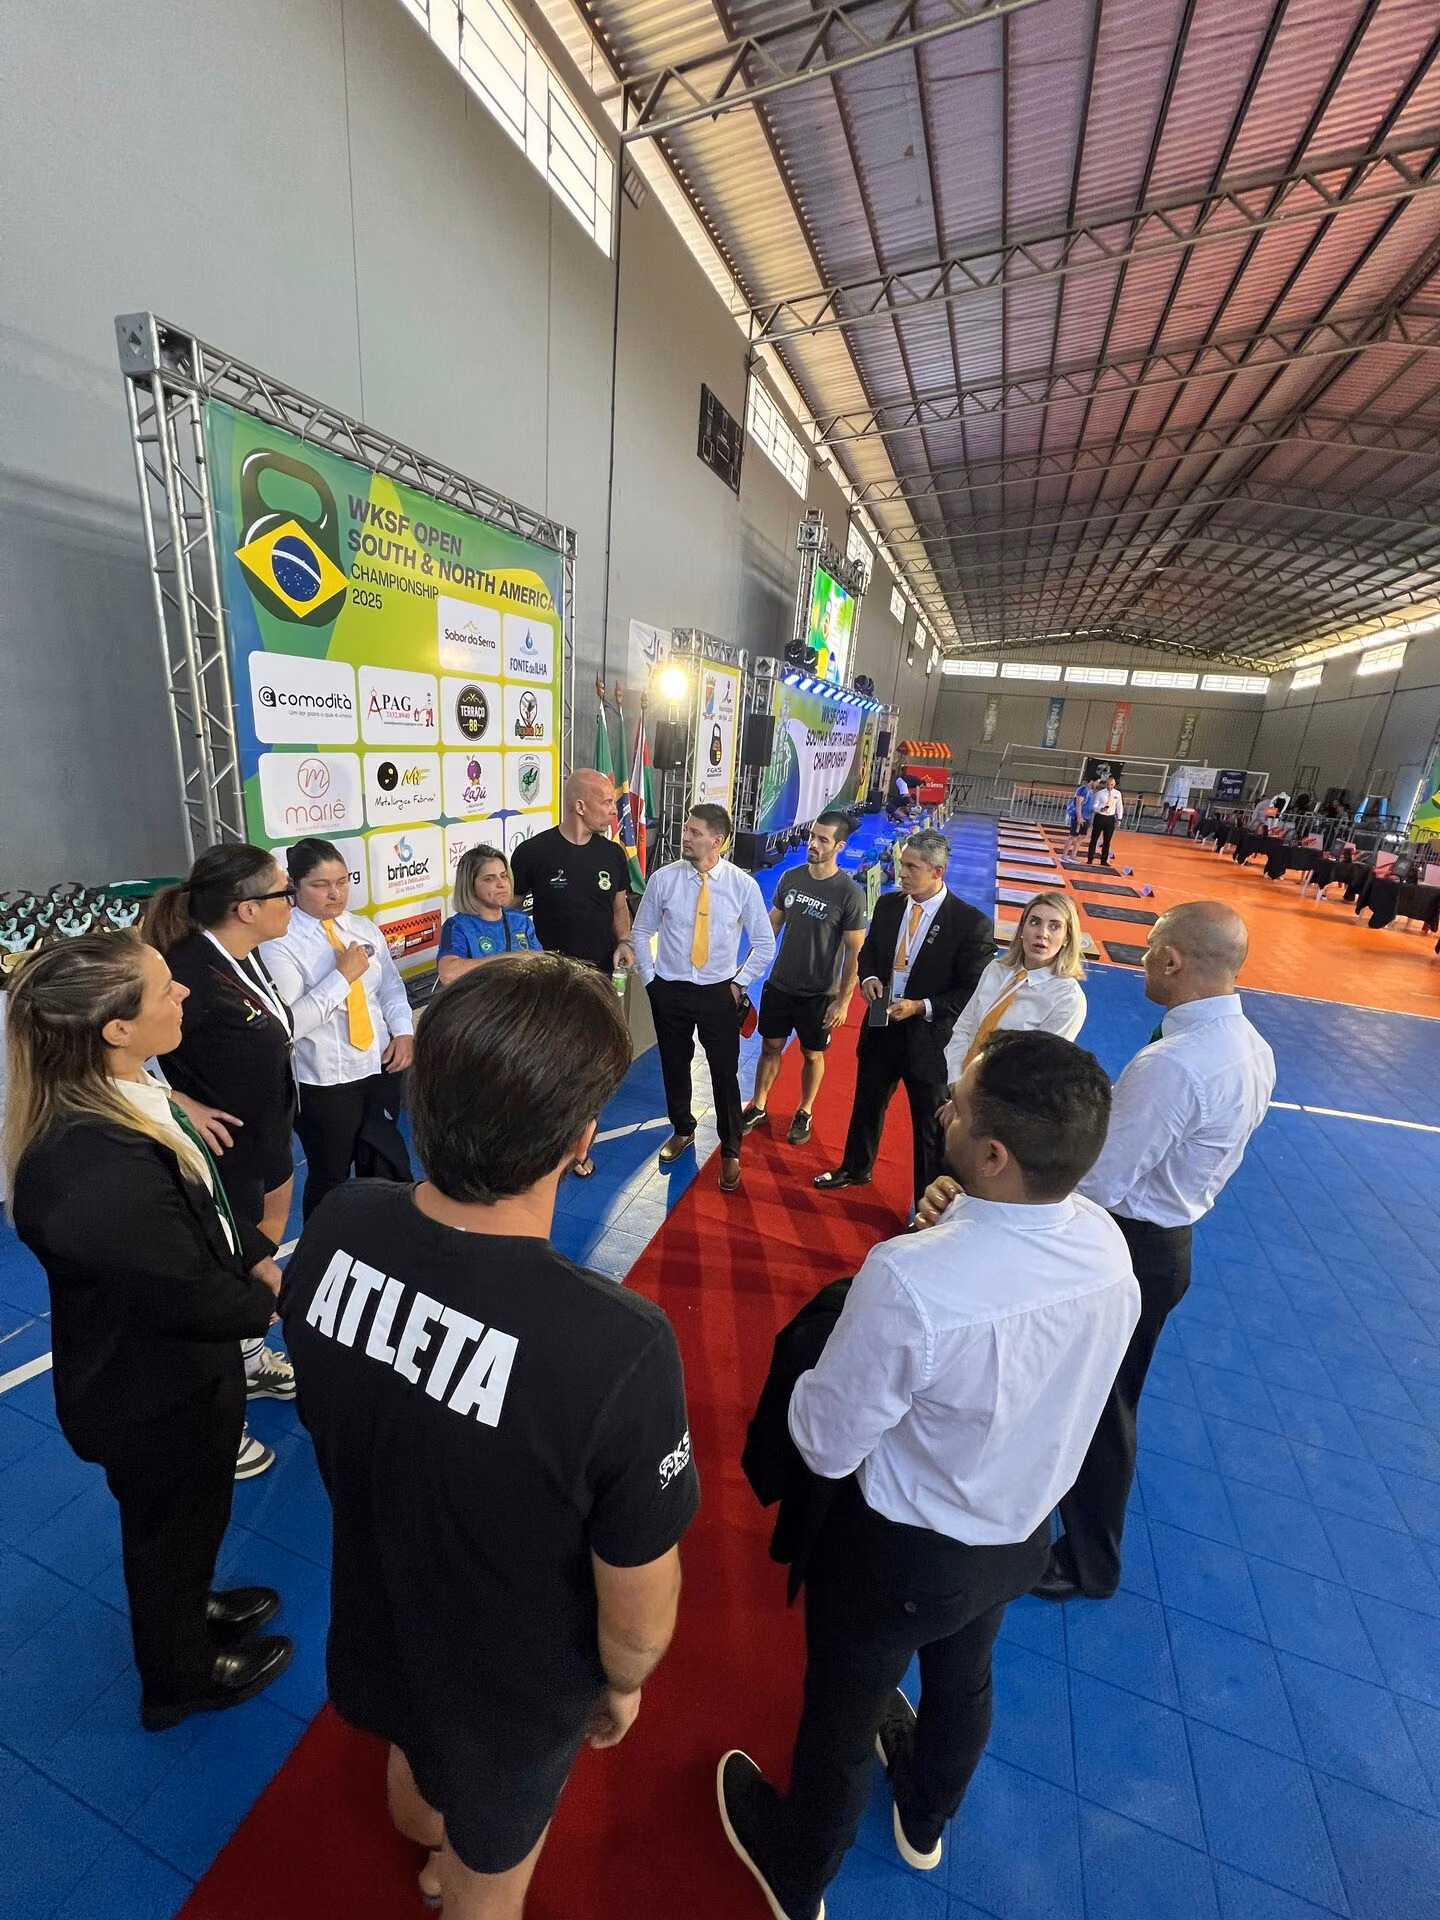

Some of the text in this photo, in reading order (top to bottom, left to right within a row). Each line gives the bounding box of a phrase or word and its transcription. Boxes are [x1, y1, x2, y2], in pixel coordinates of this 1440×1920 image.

[348, 494, 462, 557] WKSF OPEN
[347, 528, 556, 613] SOUTH & NORTH AMERICA
[351, 563, 439, 600] CHAMPIONSHIP
[352, 588, 383, 610] 2025
[444, 628, 496, 649] Sabor da Serra
[509, 657, 529, 673] FONTE
[534, 662, 548, 676] ILHA
[460, 705, 486, 719] TERRAÇO
[468, 718, 478, 732] 88
[387, 857, 429, 881] brindex
[796, 893, 828, 911] SPORT
[802, 905, 828, 920] flow
[305, 1248, 520, 1428] ATLETA
